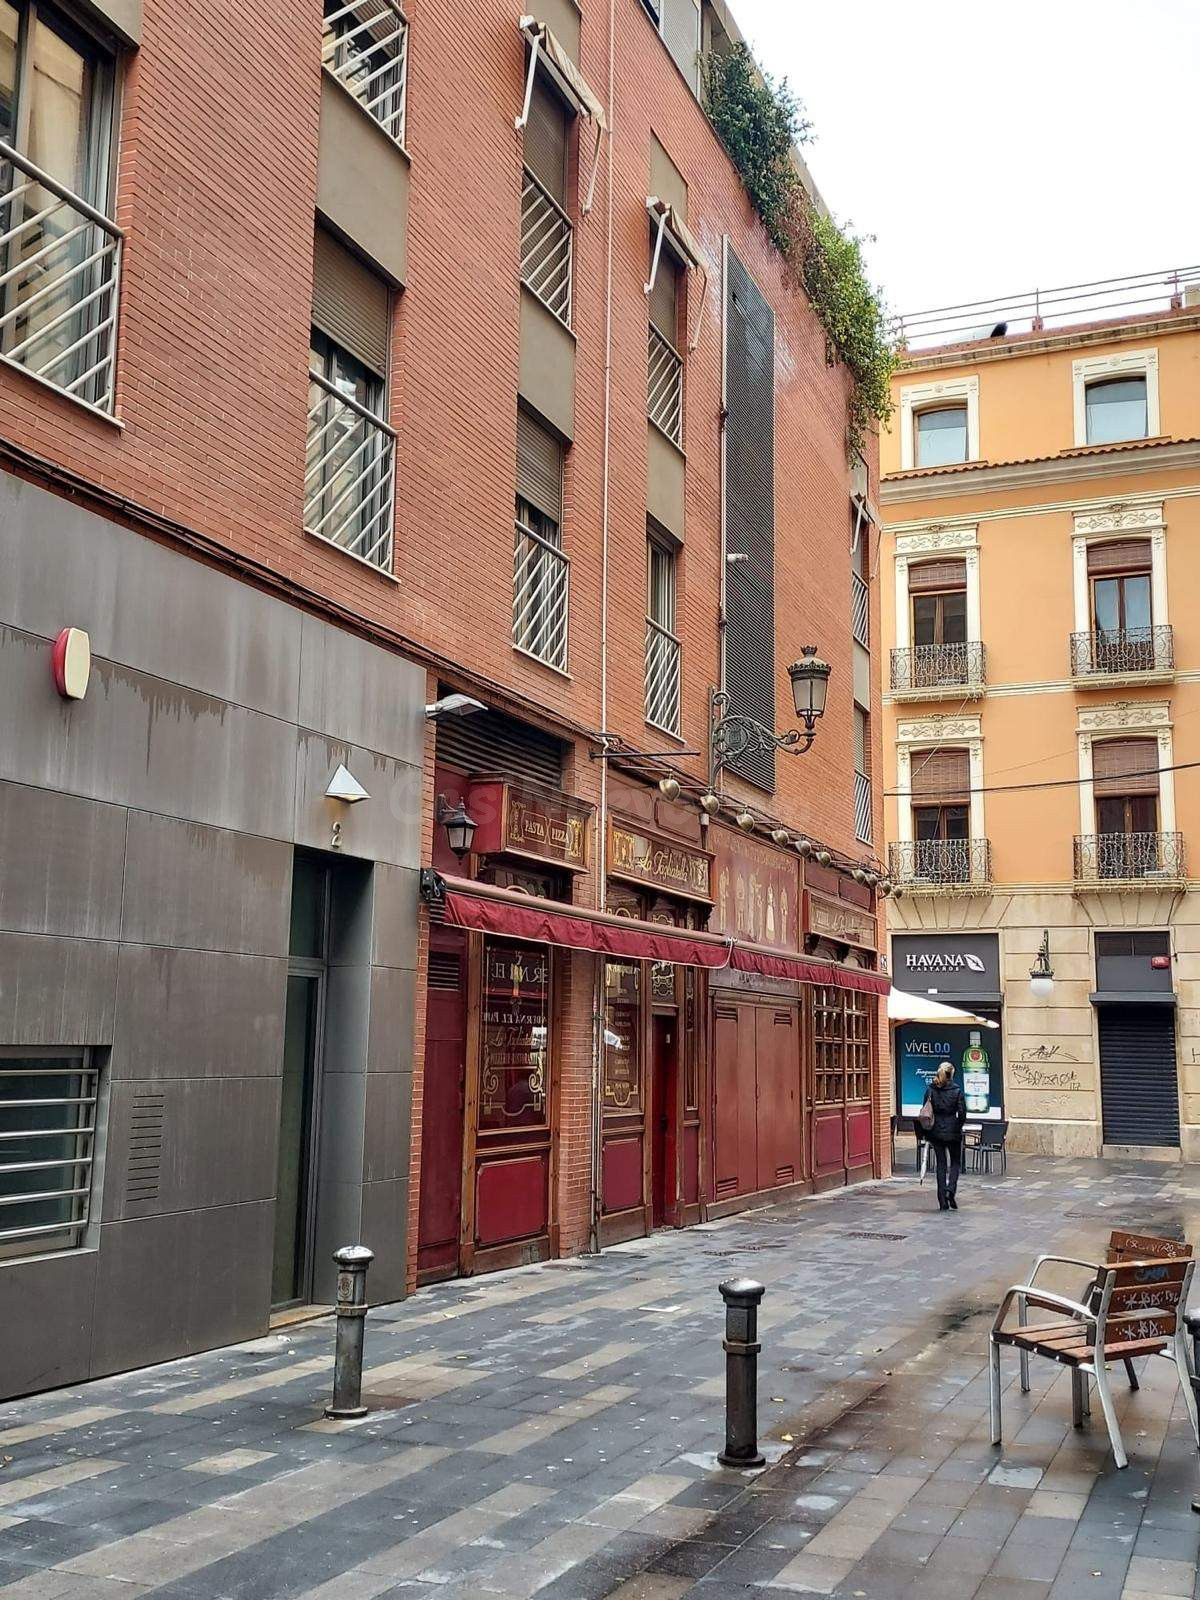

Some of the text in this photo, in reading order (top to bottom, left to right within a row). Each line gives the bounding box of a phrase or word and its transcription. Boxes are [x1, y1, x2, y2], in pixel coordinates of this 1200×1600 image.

[330, 821, 343, 849] 2
[524, 819, 545, 837] PASTA
[551, 827, 570, 844] PIZZA
[636, 845, 652, 871] La
[906, 954, 965, 966] HAVANA
